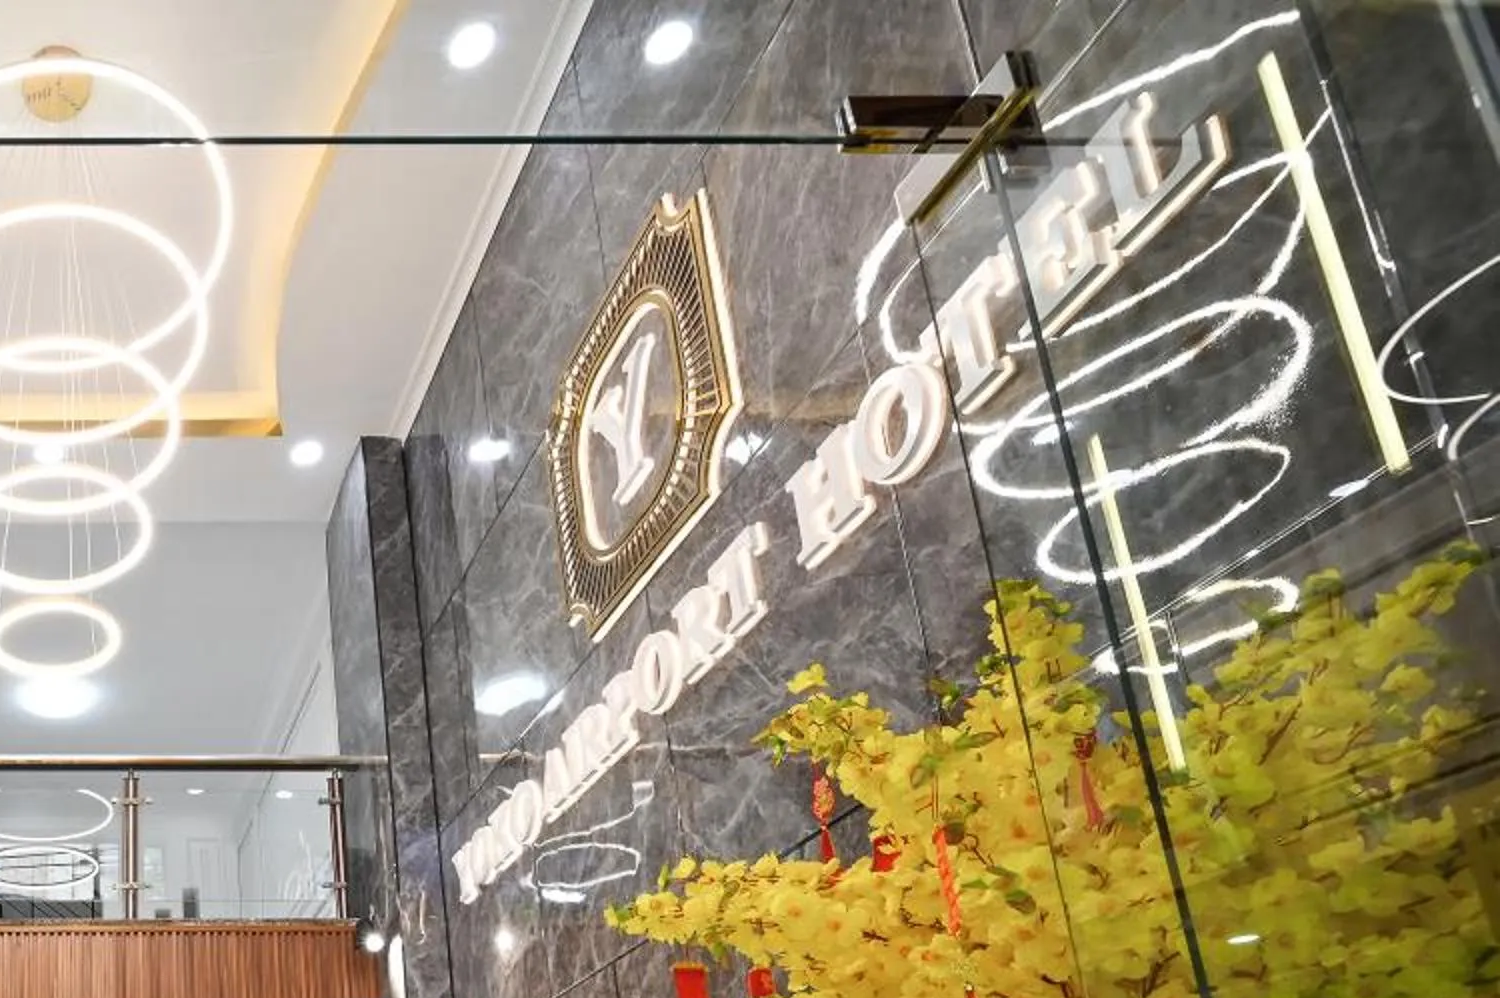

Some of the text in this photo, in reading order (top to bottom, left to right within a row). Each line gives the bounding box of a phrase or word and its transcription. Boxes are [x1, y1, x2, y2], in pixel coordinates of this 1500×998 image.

[544, 521, 769, 823] AIRPORT
[786, 91, 1231, 570] HOTEL
[587, 332, 656, 506] Y
